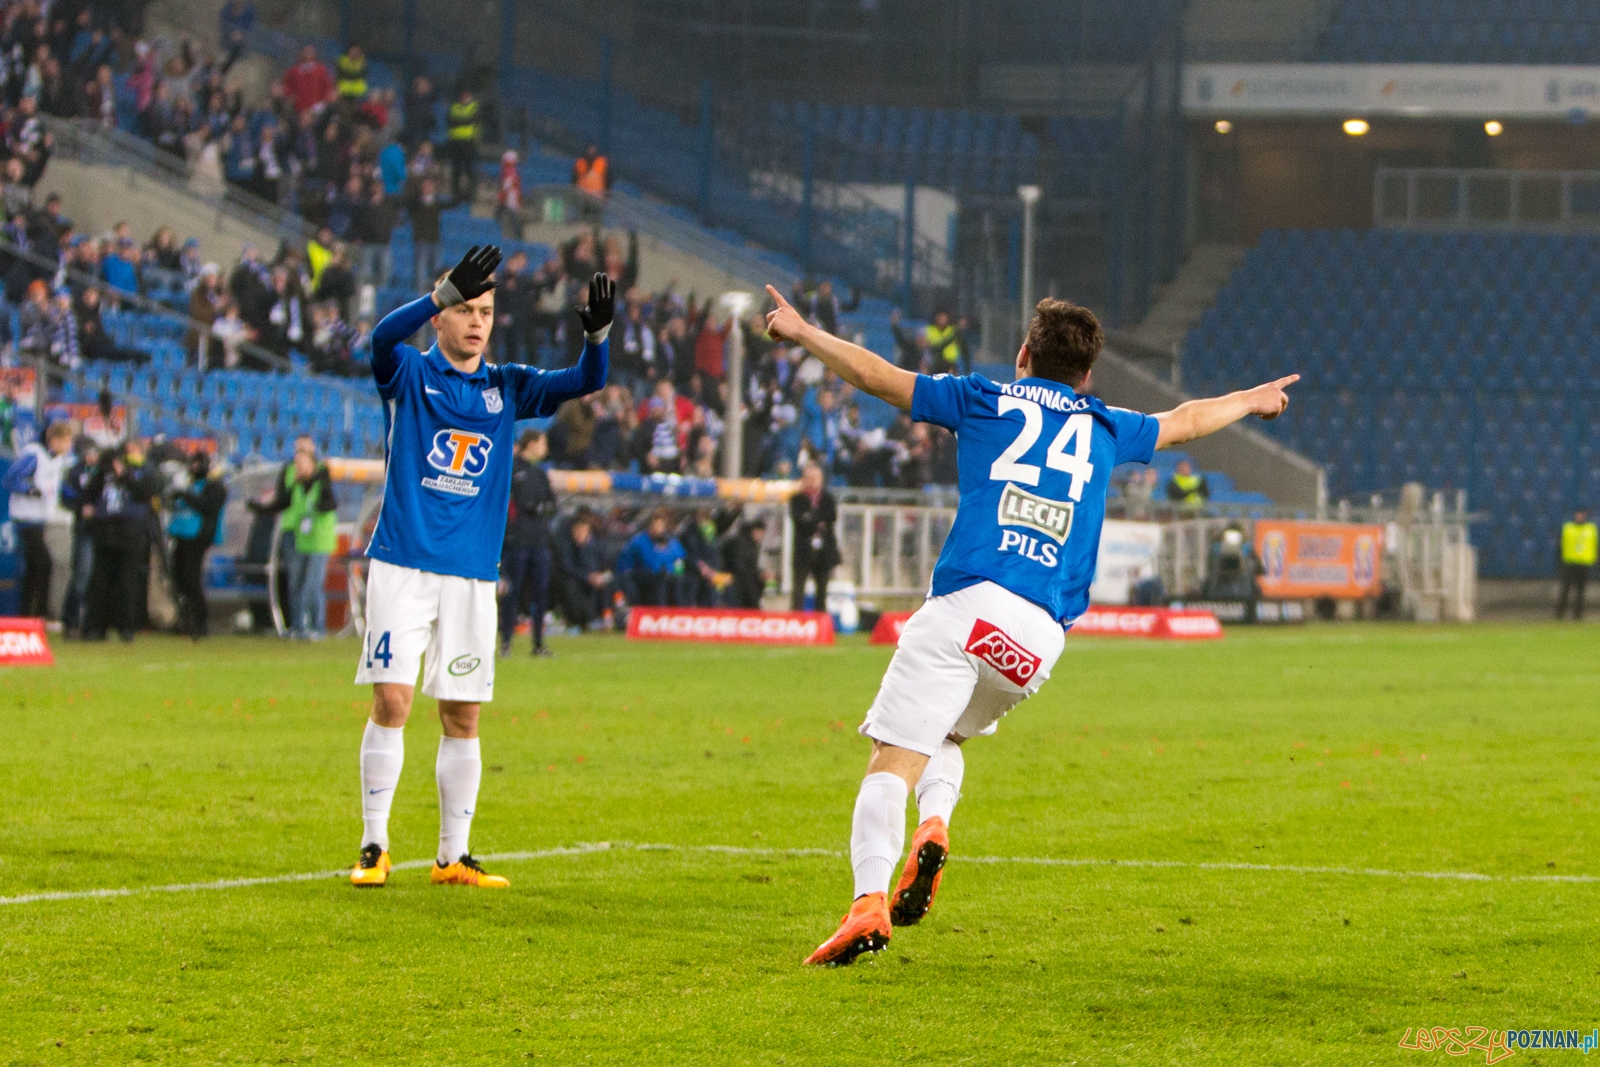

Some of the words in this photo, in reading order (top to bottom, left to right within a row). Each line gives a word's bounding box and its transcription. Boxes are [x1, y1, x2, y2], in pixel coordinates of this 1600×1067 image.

[1000, 383, 1091, 412] KOWNACKI
[427, 430, 493, 476] STS
[989, 395, 1094, 502] 24
[1006, 494, 1067, 532] LECH
[997, 529, 1059, 568] PILS
[638, 615, 818, 640] MODECOM
[455, 661, 473, 670] SGB
